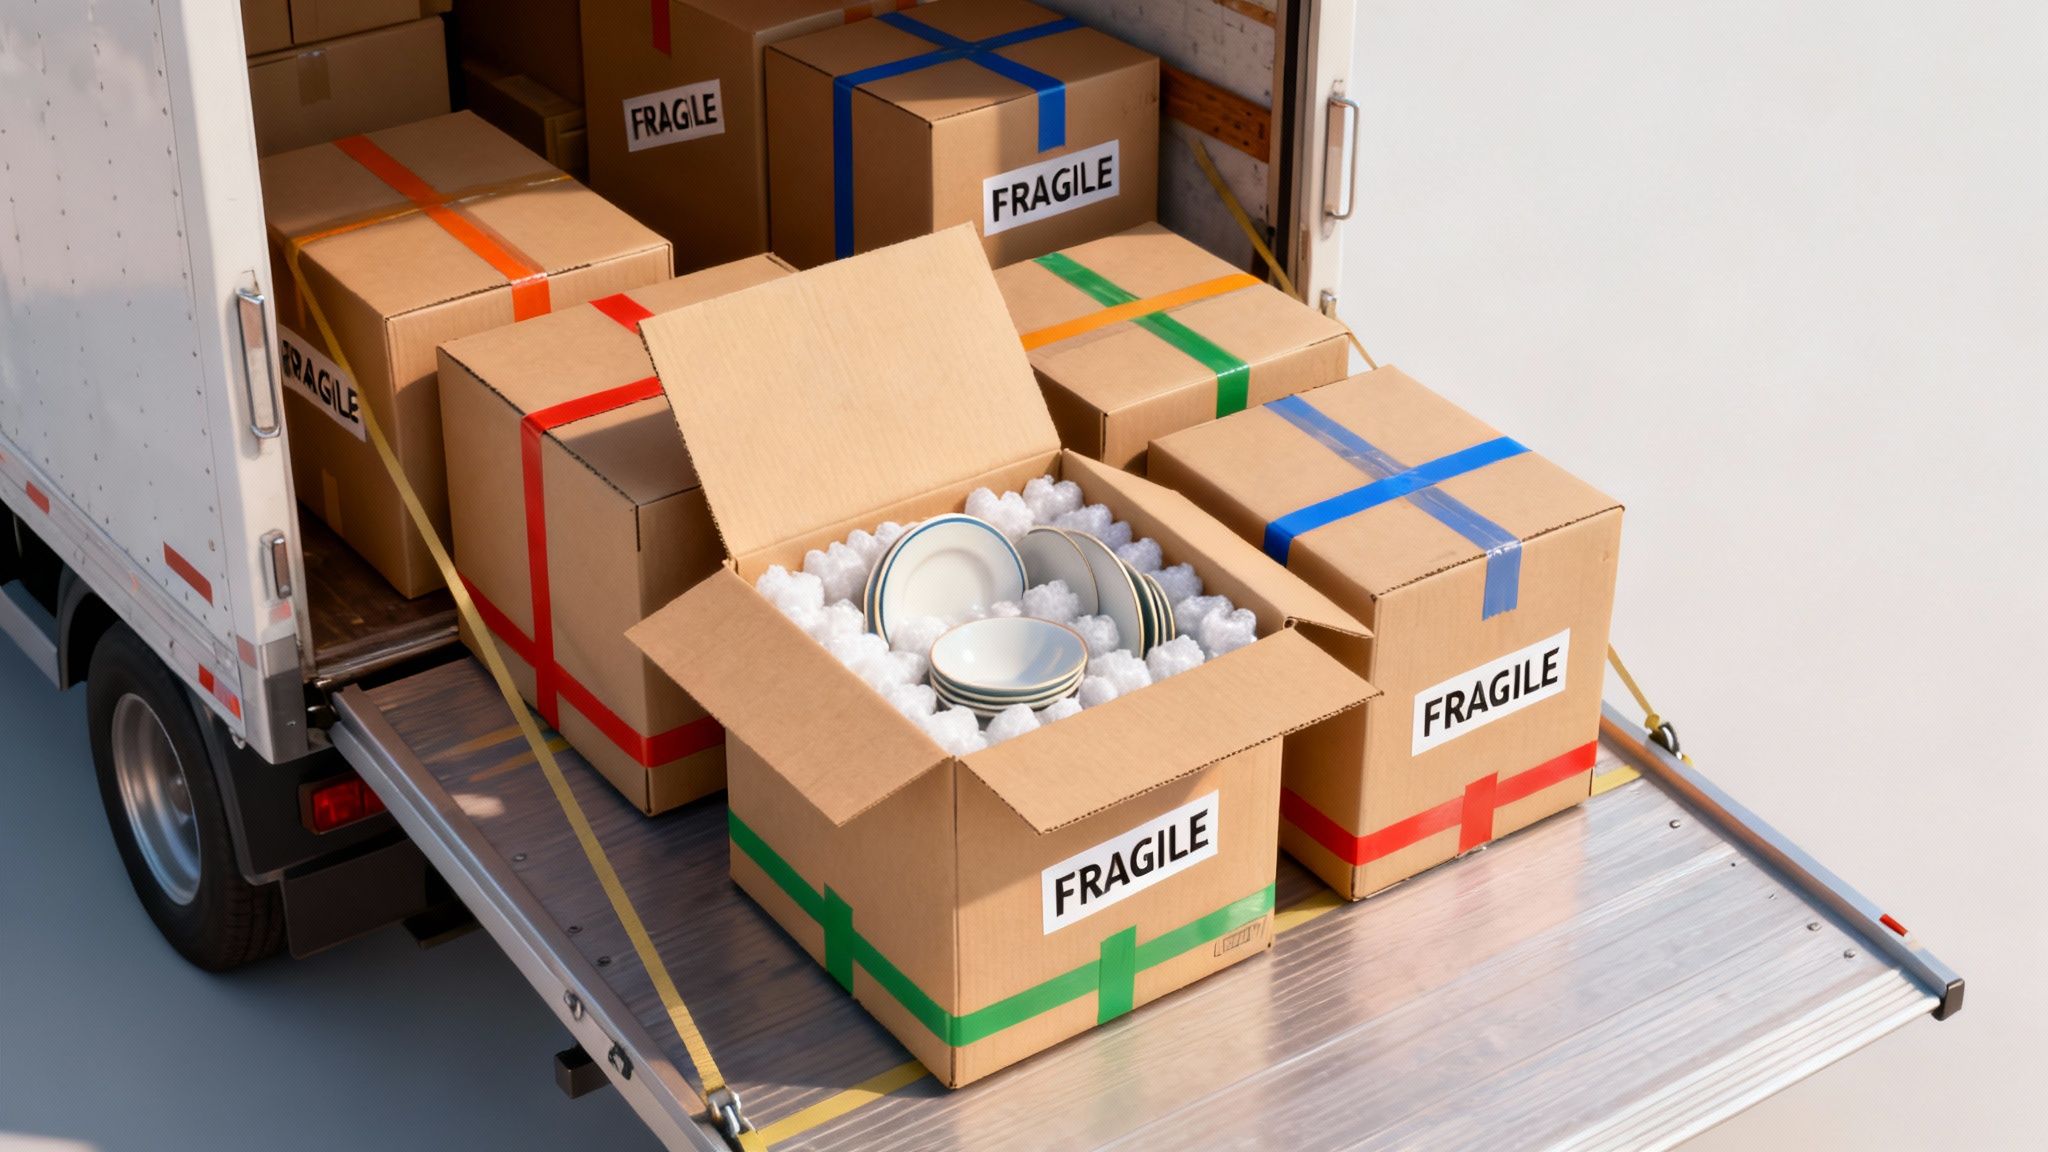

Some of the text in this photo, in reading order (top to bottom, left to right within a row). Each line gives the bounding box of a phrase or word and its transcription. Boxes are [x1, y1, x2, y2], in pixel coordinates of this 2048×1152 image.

[631, 93, 717, 140] FRAGILE
[992, 156, 1113, 222] FRAGILE
[1423, 647, 1559, 737] FRAGILE
[1054, 809, 1209, 917] FRAGILE
